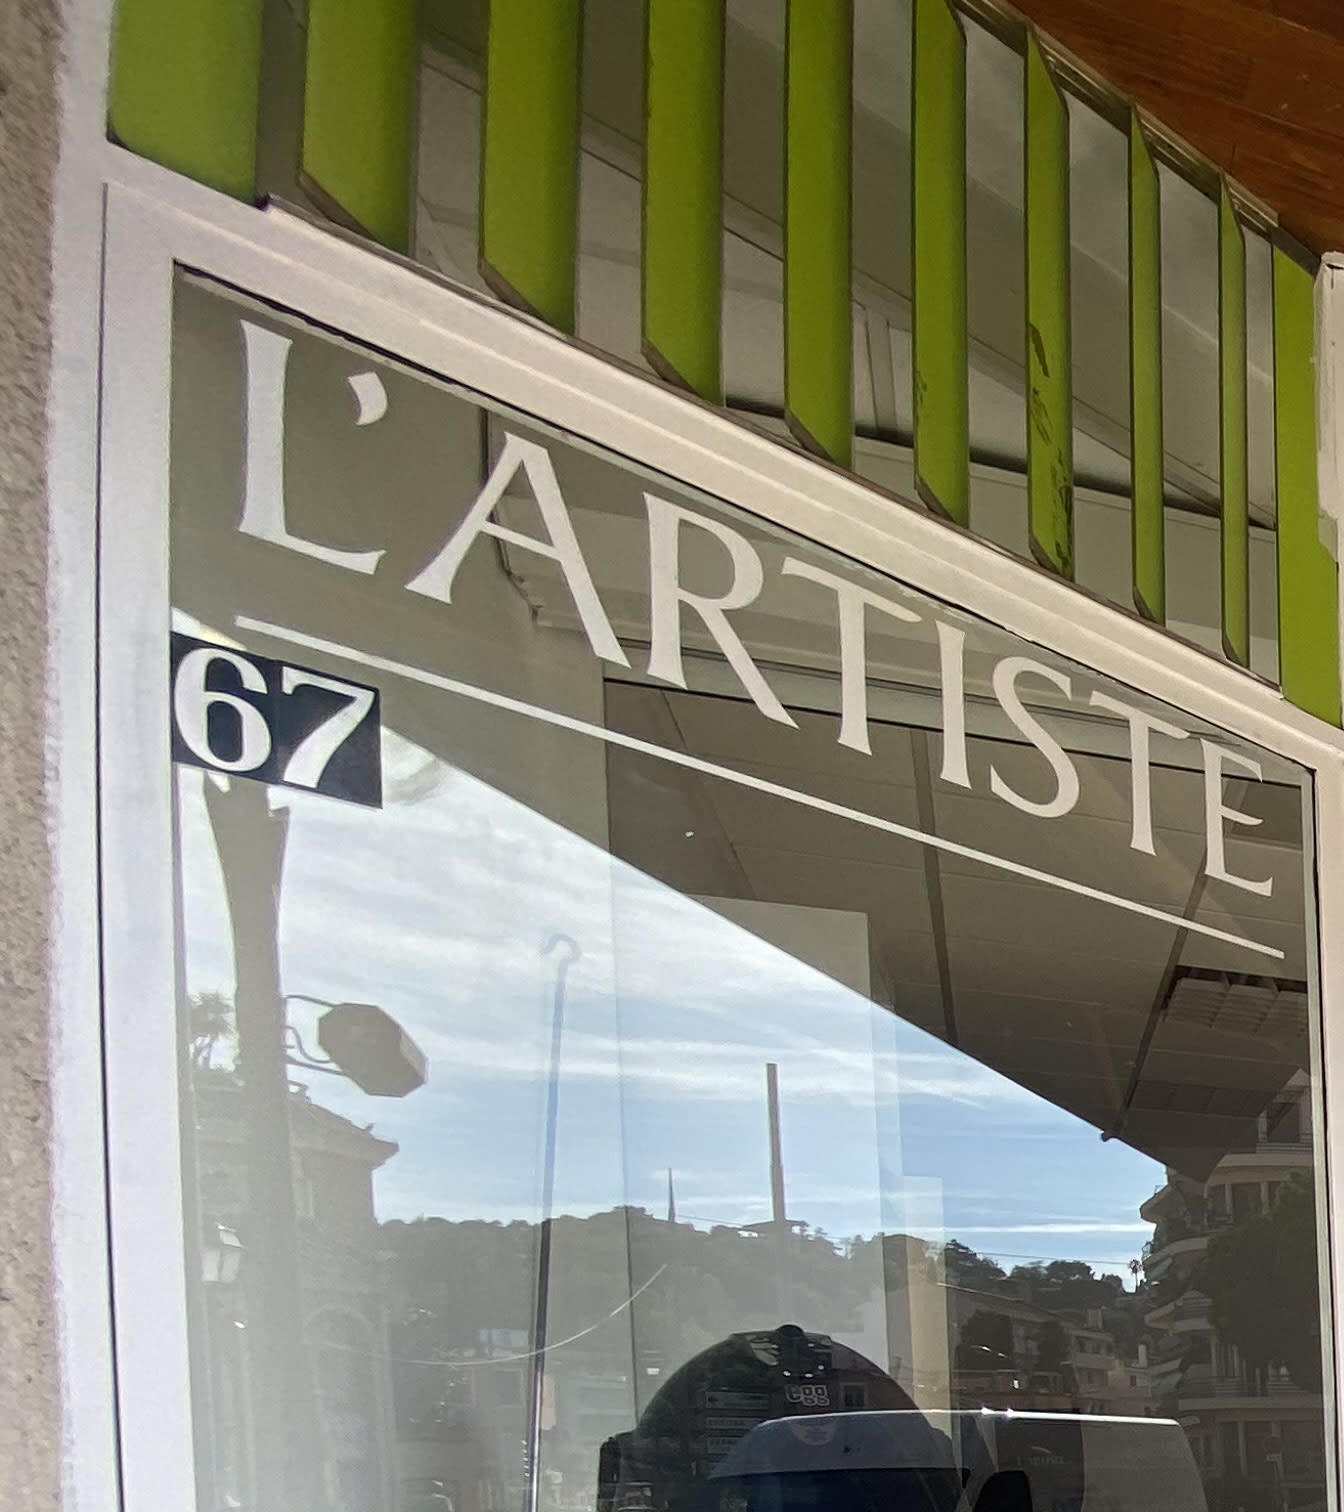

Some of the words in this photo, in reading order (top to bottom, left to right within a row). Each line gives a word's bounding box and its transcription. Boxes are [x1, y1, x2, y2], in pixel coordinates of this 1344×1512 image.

[236, 316, 1277, 898] L'ARTISTE
[173, 646, 374, 791] 67
[784, 1384, 830, 1406] egg
